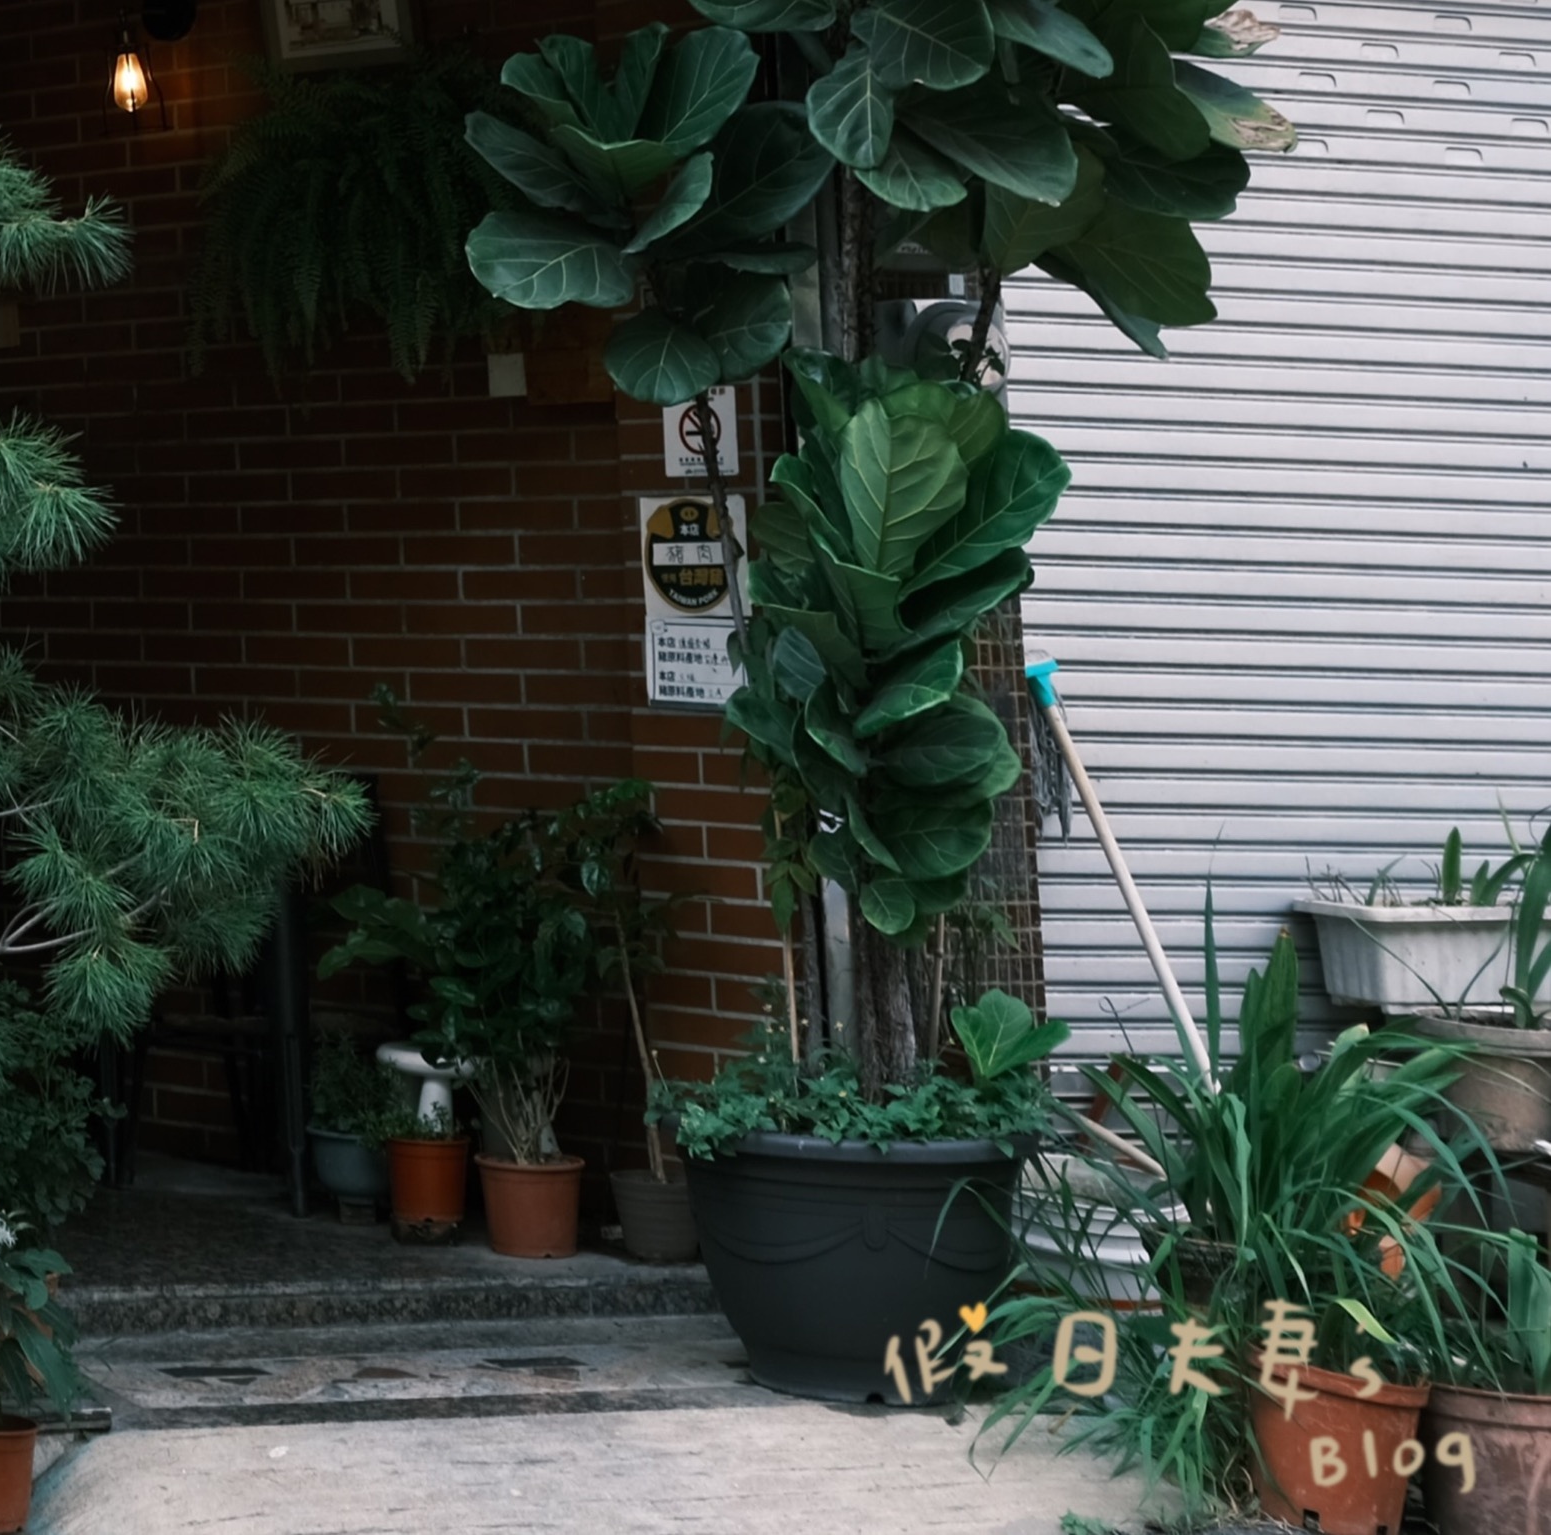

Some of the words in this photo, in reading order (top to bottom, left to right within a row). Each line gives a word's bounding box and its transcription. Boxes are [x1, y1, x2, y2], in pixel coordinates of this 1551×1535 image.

[679, 523, 699, 536] 本店
[669, 588, 698, 606] TAIWAN
[699, 588, 718, 605] PORK
